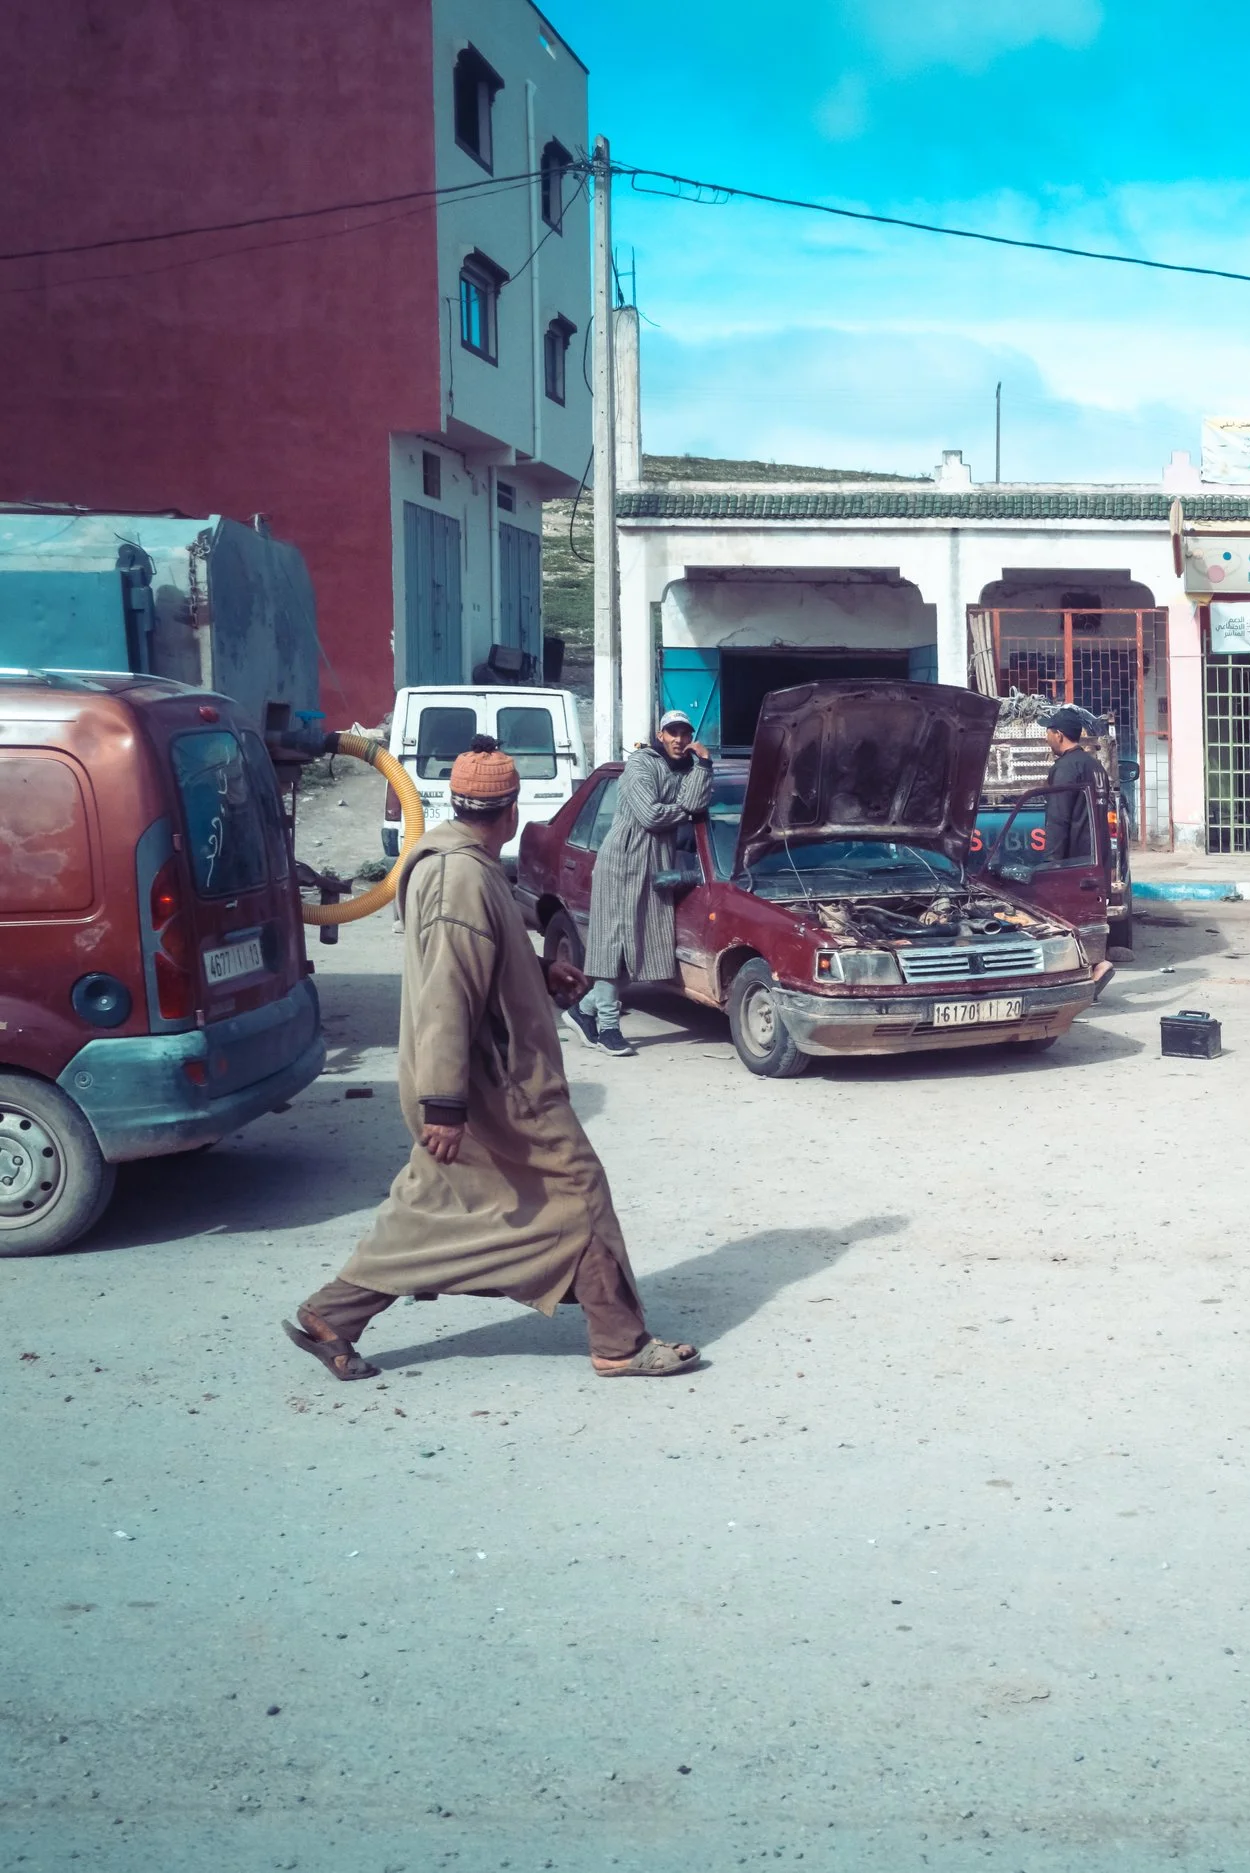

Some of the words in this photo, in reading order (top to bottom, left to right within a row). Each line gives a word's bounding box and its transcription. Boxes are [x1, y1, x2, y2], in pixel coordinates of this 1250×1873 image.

[210, 951, 232, 978] 4677
[936, 1004, 976, 1024] 16170
[1006, 1000, 1021, 1018] 20
